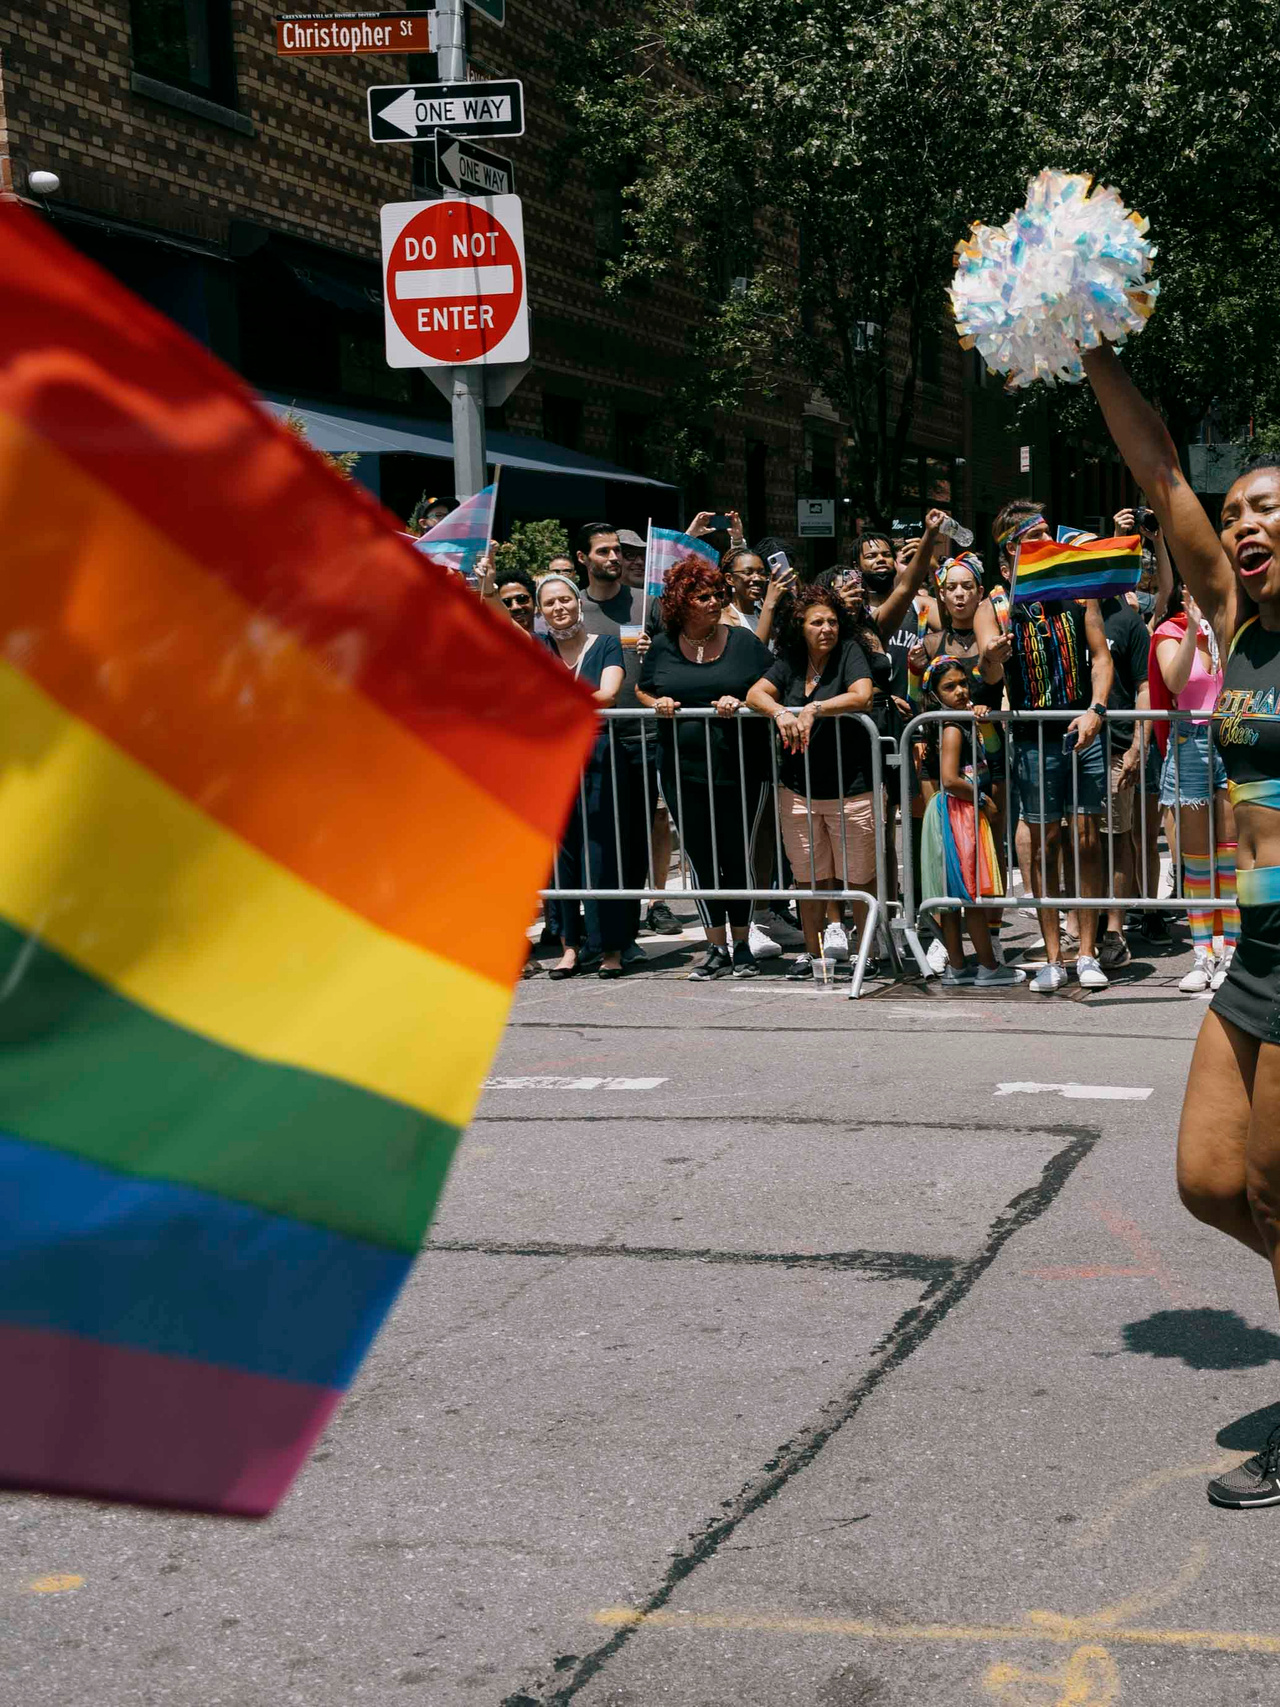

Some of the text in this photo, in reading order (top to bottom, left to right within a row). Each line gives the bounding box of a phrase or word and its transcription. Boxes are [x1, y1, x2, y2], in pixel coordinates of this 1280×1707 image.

[283, 20, 413, 52] Christopher St
[415, 99, 505, 122] ONE WAY
[459, 156, 505, 192] ONE WAY
[404, 232, 500, 261] DO NOT
[417, 305, 495, 332] ENTER
